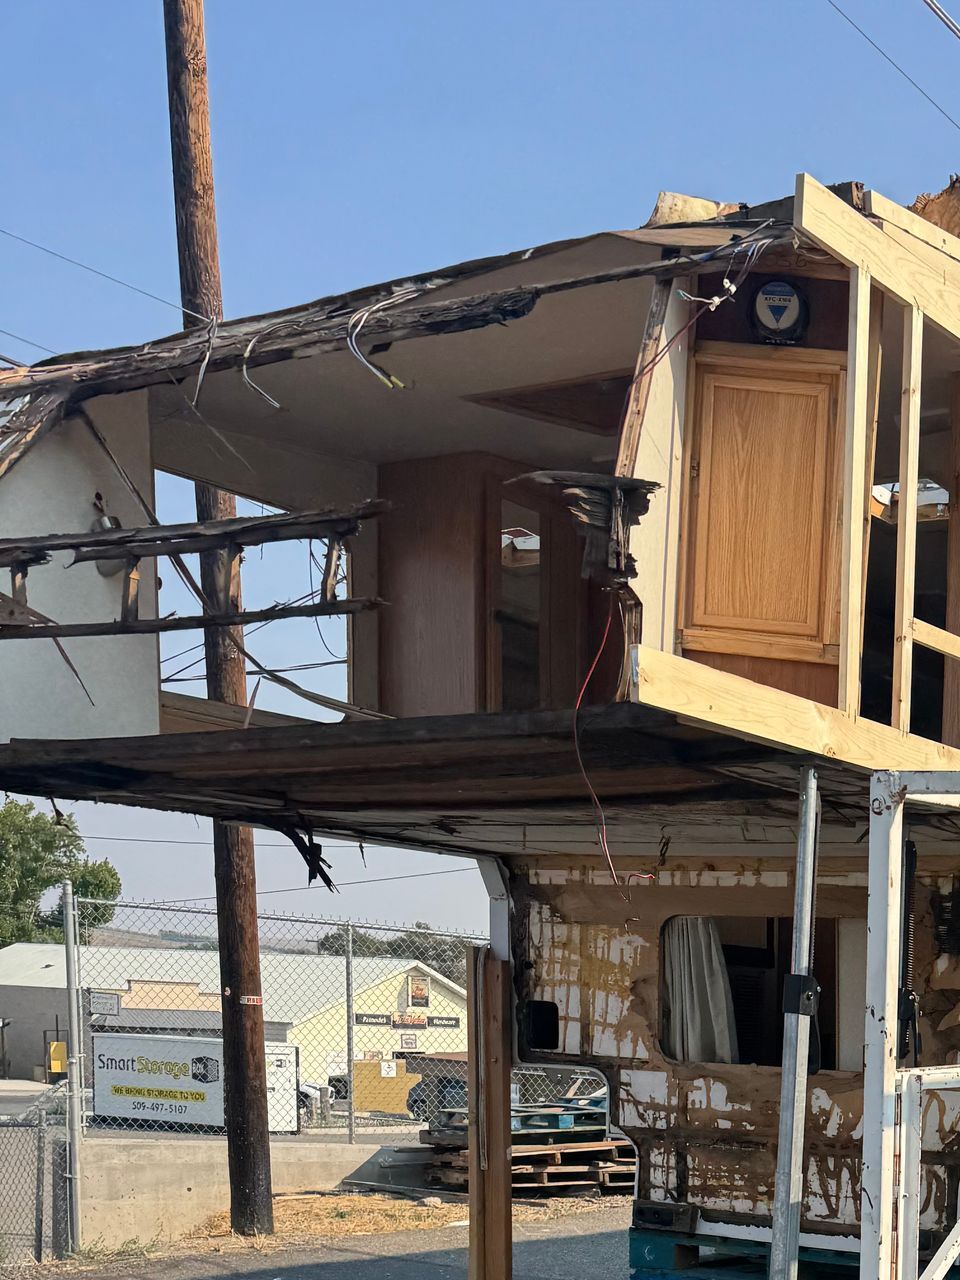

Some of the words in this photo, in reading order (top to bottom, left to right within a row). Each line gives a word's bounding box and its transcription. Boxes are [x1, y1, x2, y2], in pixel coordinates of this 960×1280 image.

[113, 1086, 124, 1095] WE
[146, 1088, 178, 1099] STORAGE
[180, 1091, 189, 1099] TO
[190, 1091, 206, 1101] YOU
[132, 1101, 188, 1114] 509-497-5107
